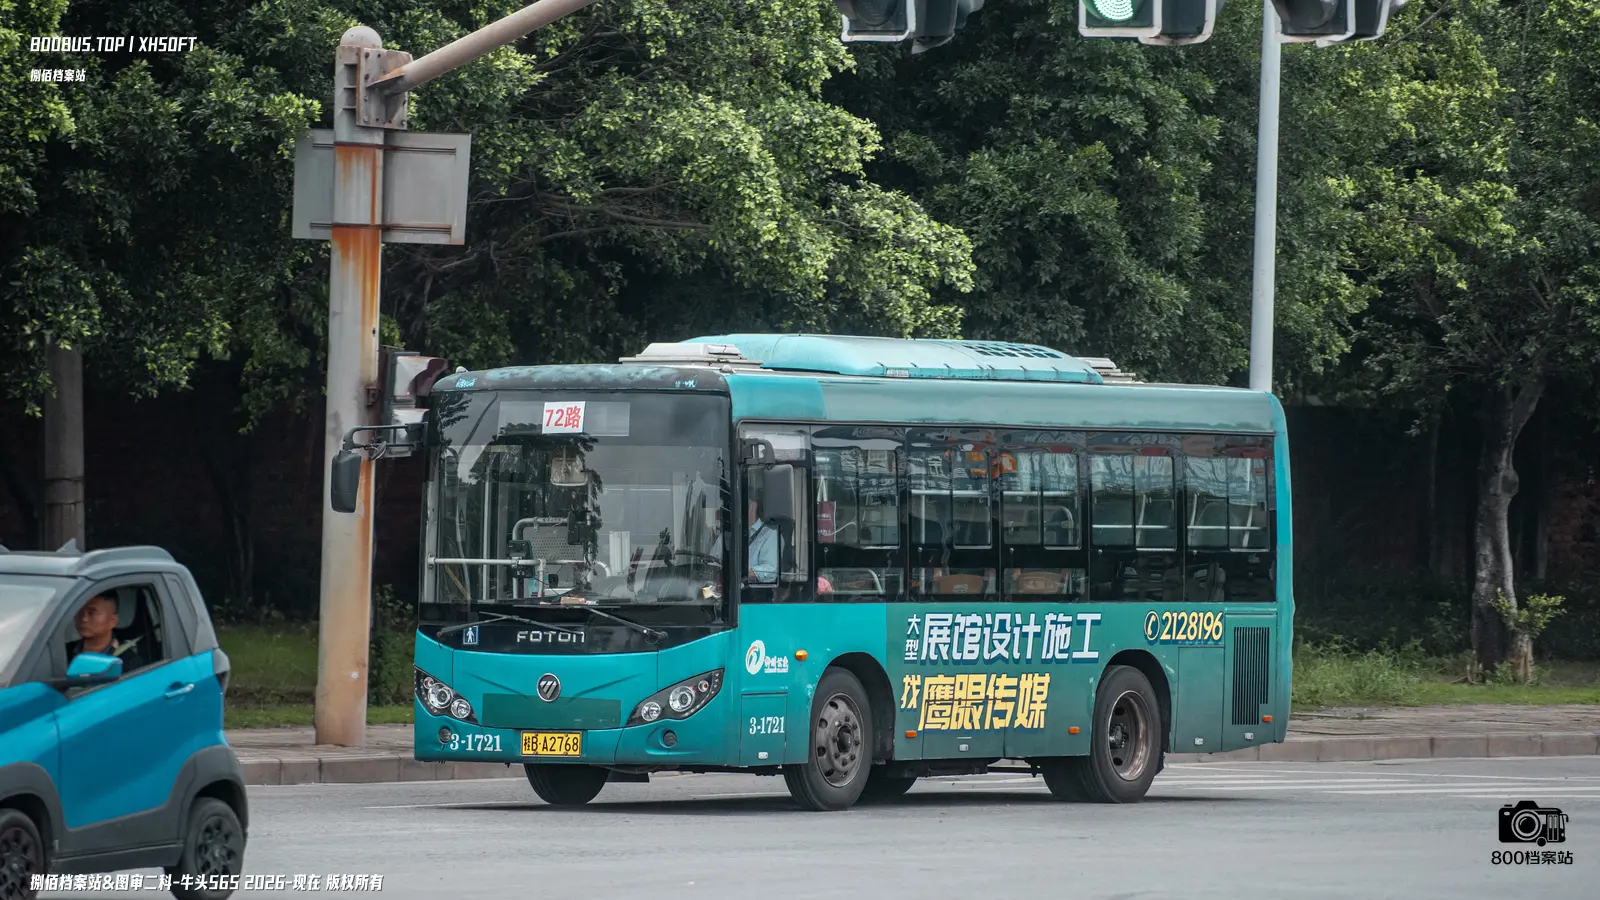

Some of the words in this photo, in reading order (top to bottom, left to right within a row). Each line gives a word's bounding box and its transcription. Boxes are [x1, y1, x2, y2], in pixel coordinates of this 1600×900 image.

[545, 406, 581, 428] 72路
[517, 631, 585, 643] FOTON
[919, 612, 1101, 661] 展馆设计施工
[1160, 611, 1223, 641] 2128196
[904, 614, 919, 661] 大型
[749, 716, 785, 735] 3-1721
[450, 733, 503, 752] 3-1721
